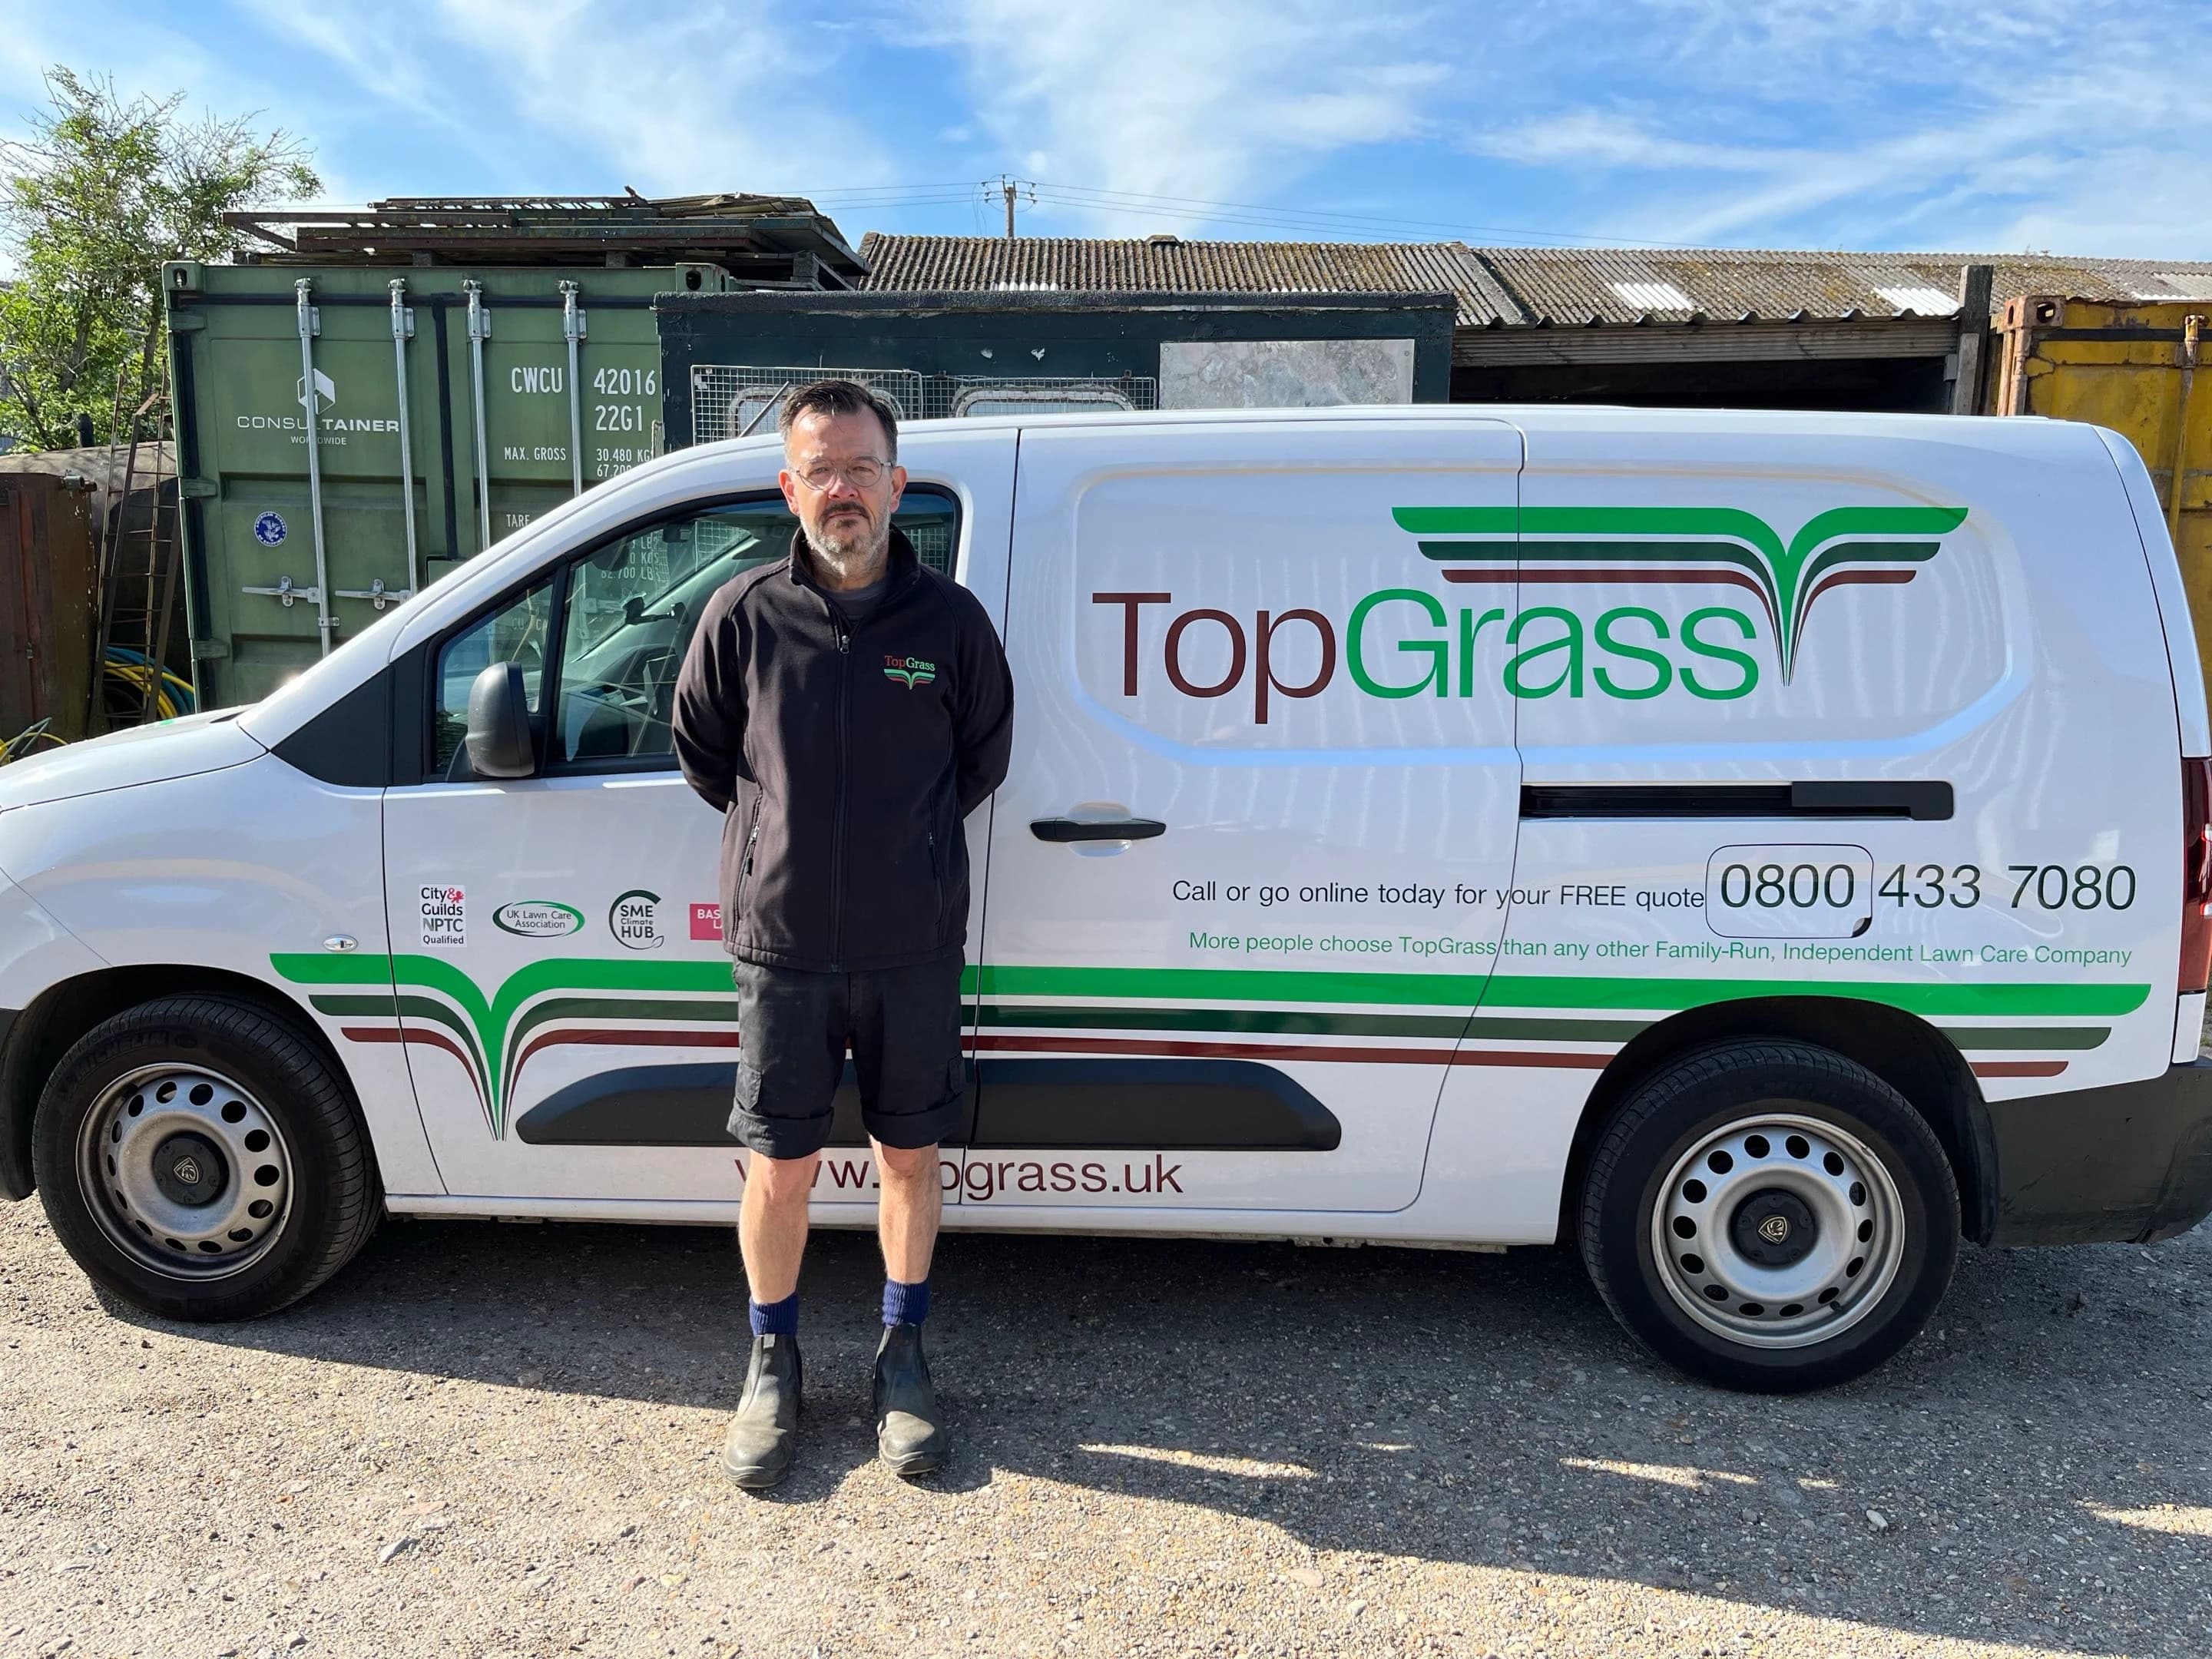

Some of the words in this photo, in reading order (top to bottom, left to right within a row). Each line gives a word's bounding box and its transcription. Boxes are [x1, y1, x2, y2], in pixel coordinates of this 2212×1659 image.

[512, 367, 562, 393] CWCU
[594, 368, 656, 395] 42016
[237, 416, 399, 432] CONSUTAINER
[595, 406, 642, 432] 22G1
[290, 435, 347, 445] WODWIDE
[504, 447, 529, 460] MAX.
[534, 447, 567, 461] GROSS
[596, 448, 632, 462] 30.480
[506, 514, 530, 528] TARE
[884, 655, 935, 671] TopGrass
[1092, 588, 1759, 725] TopGrass
[1173, 880, 1216, 902] Call
[1227, 886, 1250, 902] or
[1260, 886, 1290, 907] go
[1300, 882, 1368, 903] online
[1378, 882, 1445, 909] today
[1455, 883, 1487, 905] for
[1496, 888, 1551, 909] your
[1561, 886, 1627, 906] FREE
[1636, 888, 1704, 912] quote
[1720, 863, 1855, 909] 0800
[1879, 863, 1981, 909] 433
[2008, 864, 2136, 911] 7080
[421, 902, 463, 916] Guilds
[506, 910, 519, 919] UK
[523, 910, 548, 920] Lawn
[551, 911, 572, 920] Care
[620, 904, 654, 918] SME
[422, 917, 463, 932] NPTC
[515, 919, 565, 929] Association
[621, 917, 654, 926] Climate
[621, 926, 654, 939] HUB
[422, 935, 464, 945] Qualified
[1189, 932, 1240, 949] More
[1247, 934, 1313, 954] people
[1320, 935, 1392, 952] choose
[1399, 936, 1496, 957] TopGrass
[1503, 939, 1547, 956] than
[1554, 942, 1590, 960] any
[1596, 940, 1649, 958] other
[1655, 941, 1775, 962] Family-Run,
[1783, 942, 1914, 964] Independent
[1920, 945, 1974, 963] Lawn
[1979, 945, 2028, 964] Care
[2035, 945, 2132, 968] Company
